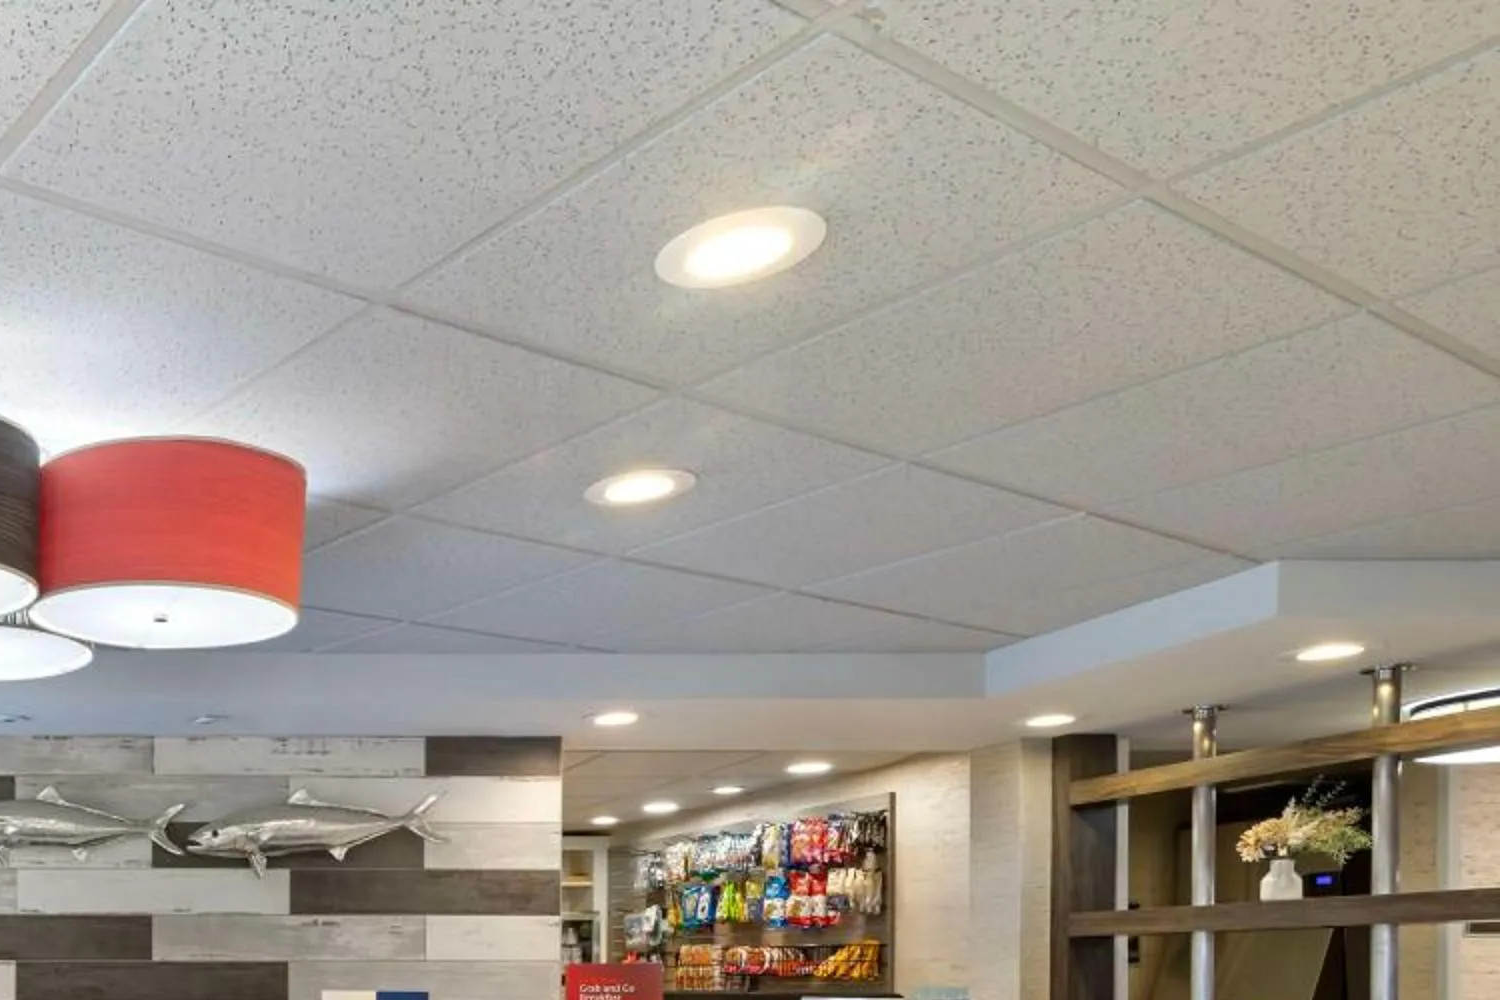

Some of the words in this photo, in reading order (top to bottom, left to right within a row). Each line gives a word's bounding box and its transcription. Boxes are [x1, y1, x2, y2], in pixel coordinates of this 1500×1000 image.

[580, 983, 600, 993] Grab
[603, 983, 620, 993] and
[622, 983, 635, 993] Go
